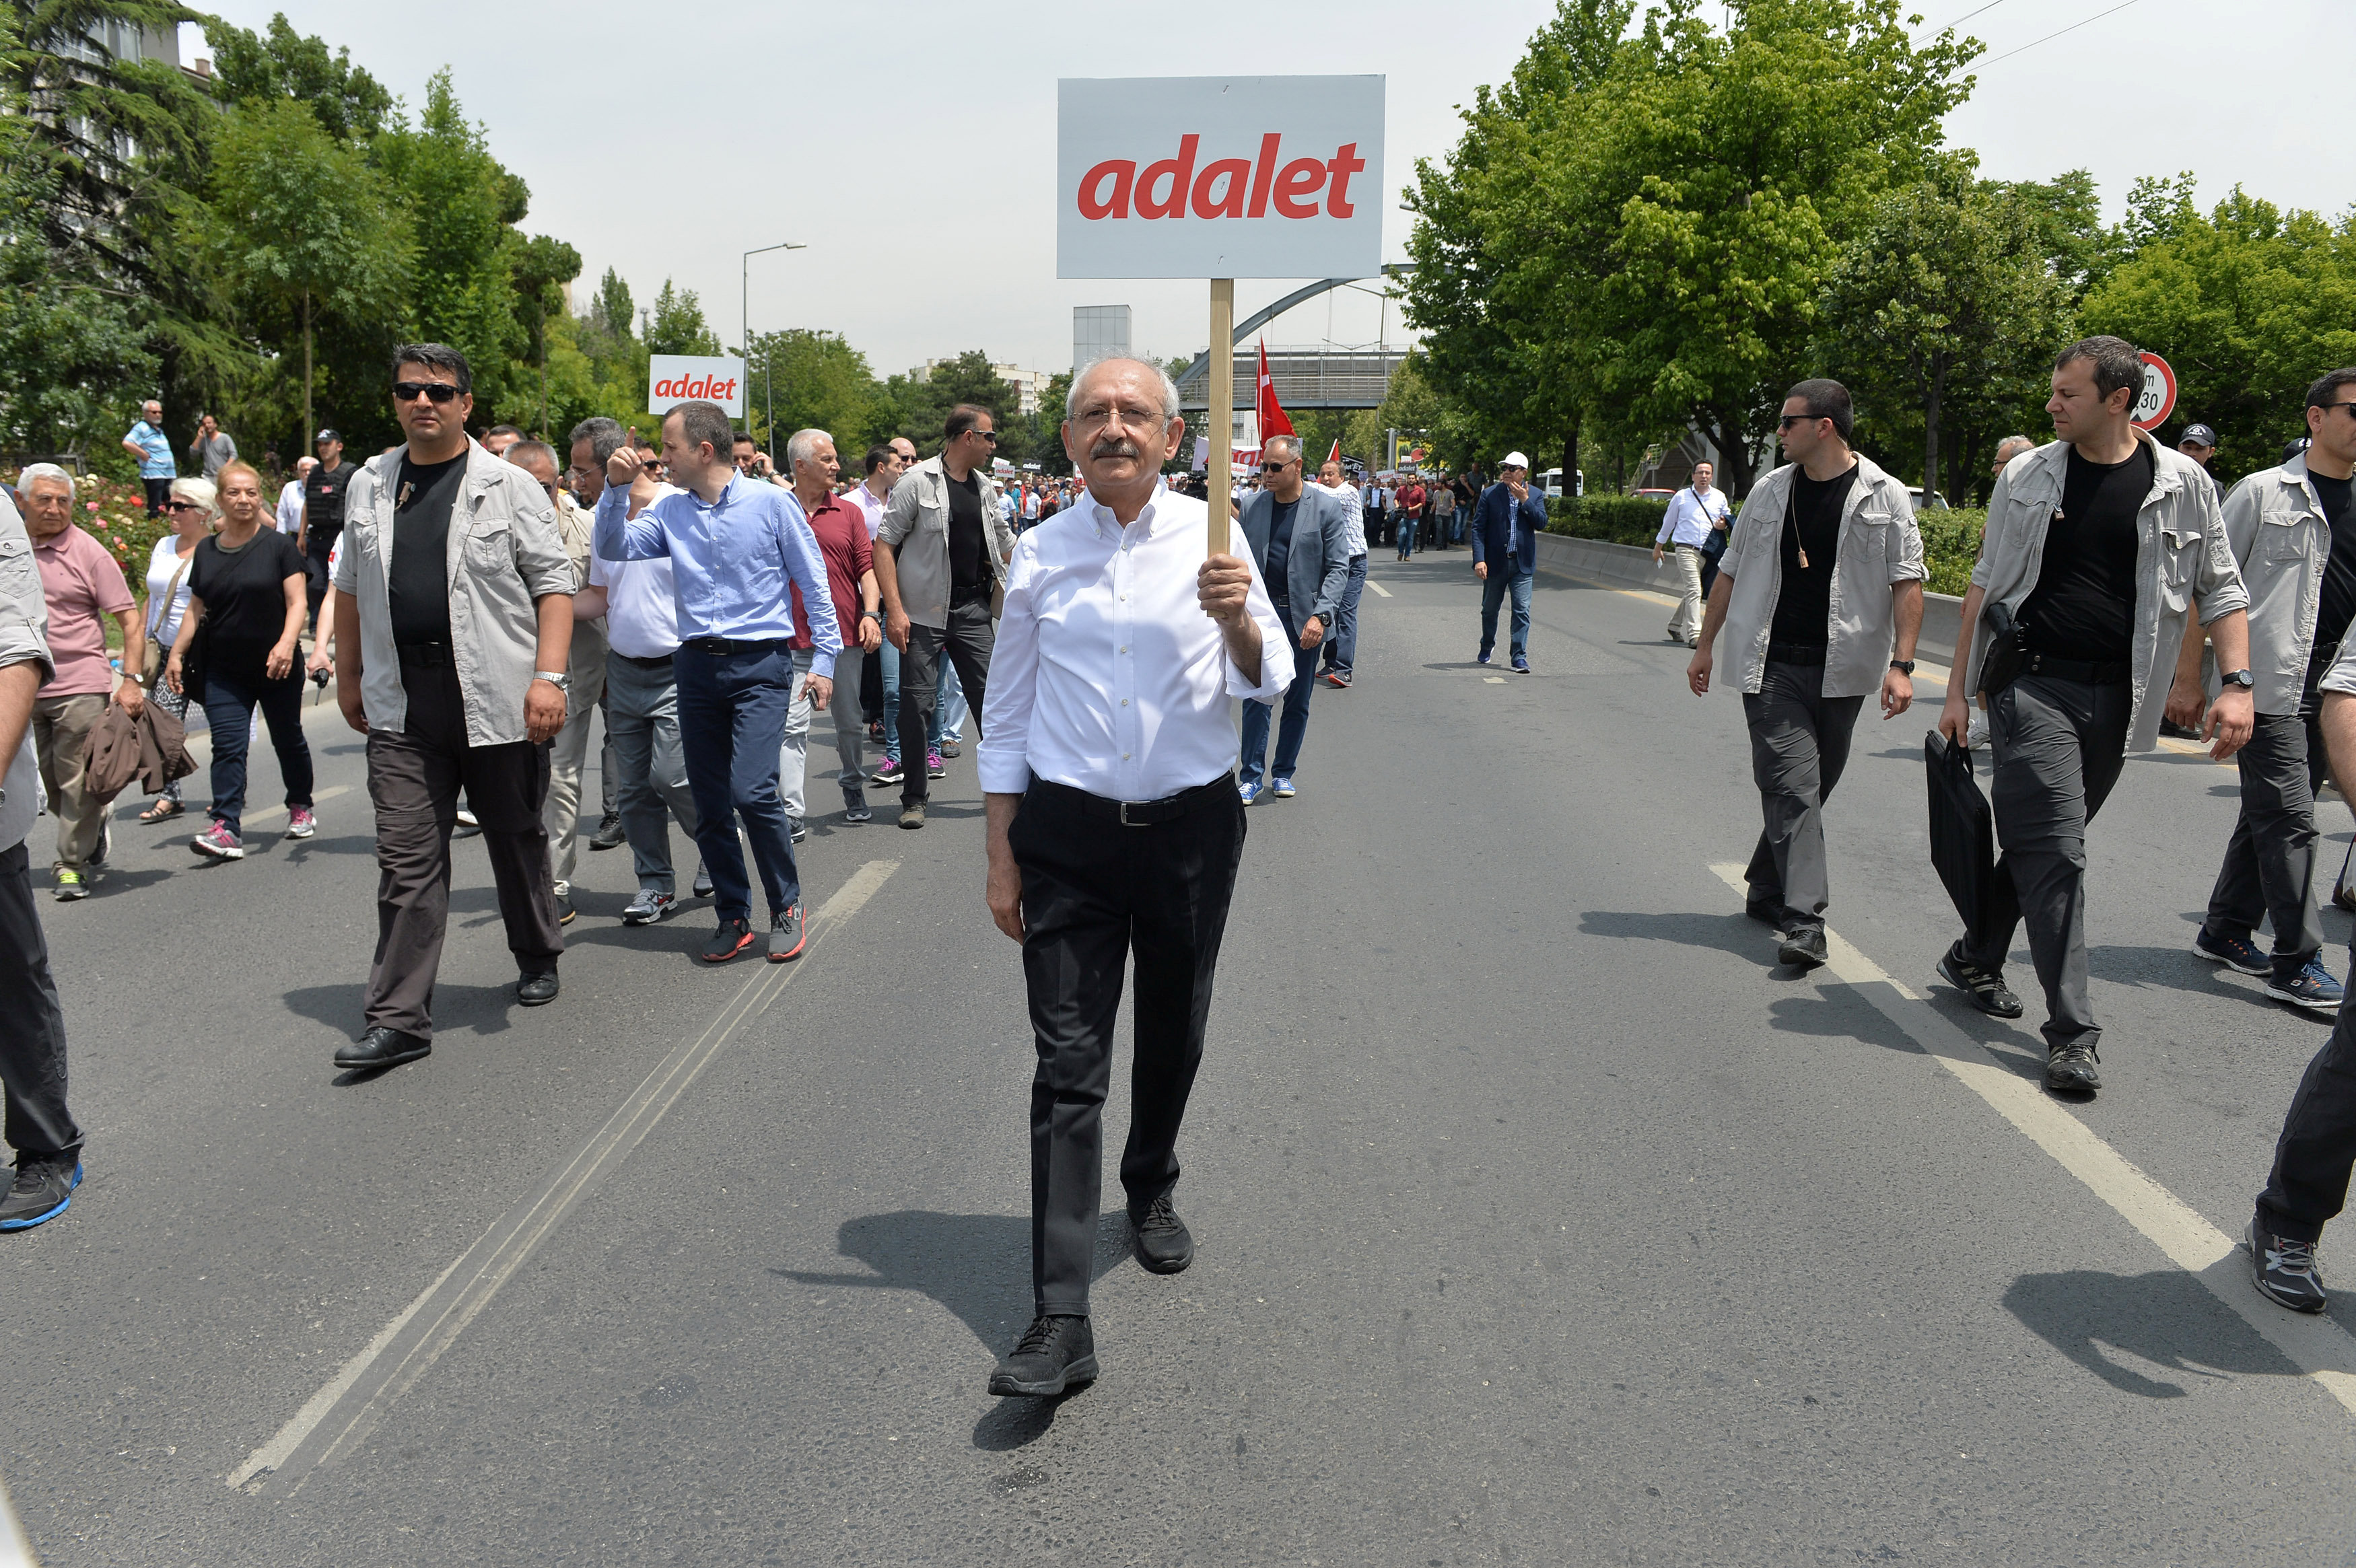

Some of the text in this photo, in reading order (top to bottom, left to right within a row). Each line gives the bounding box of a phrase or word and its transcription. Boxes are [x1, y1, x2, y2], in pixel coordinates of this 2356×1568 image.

[1077, 133, 1366, 220] adalet
[655, 373, 736, 400] adalet
[2145, 374, 2155, 387] m
[2135, 392, 2158, 411] ,30
